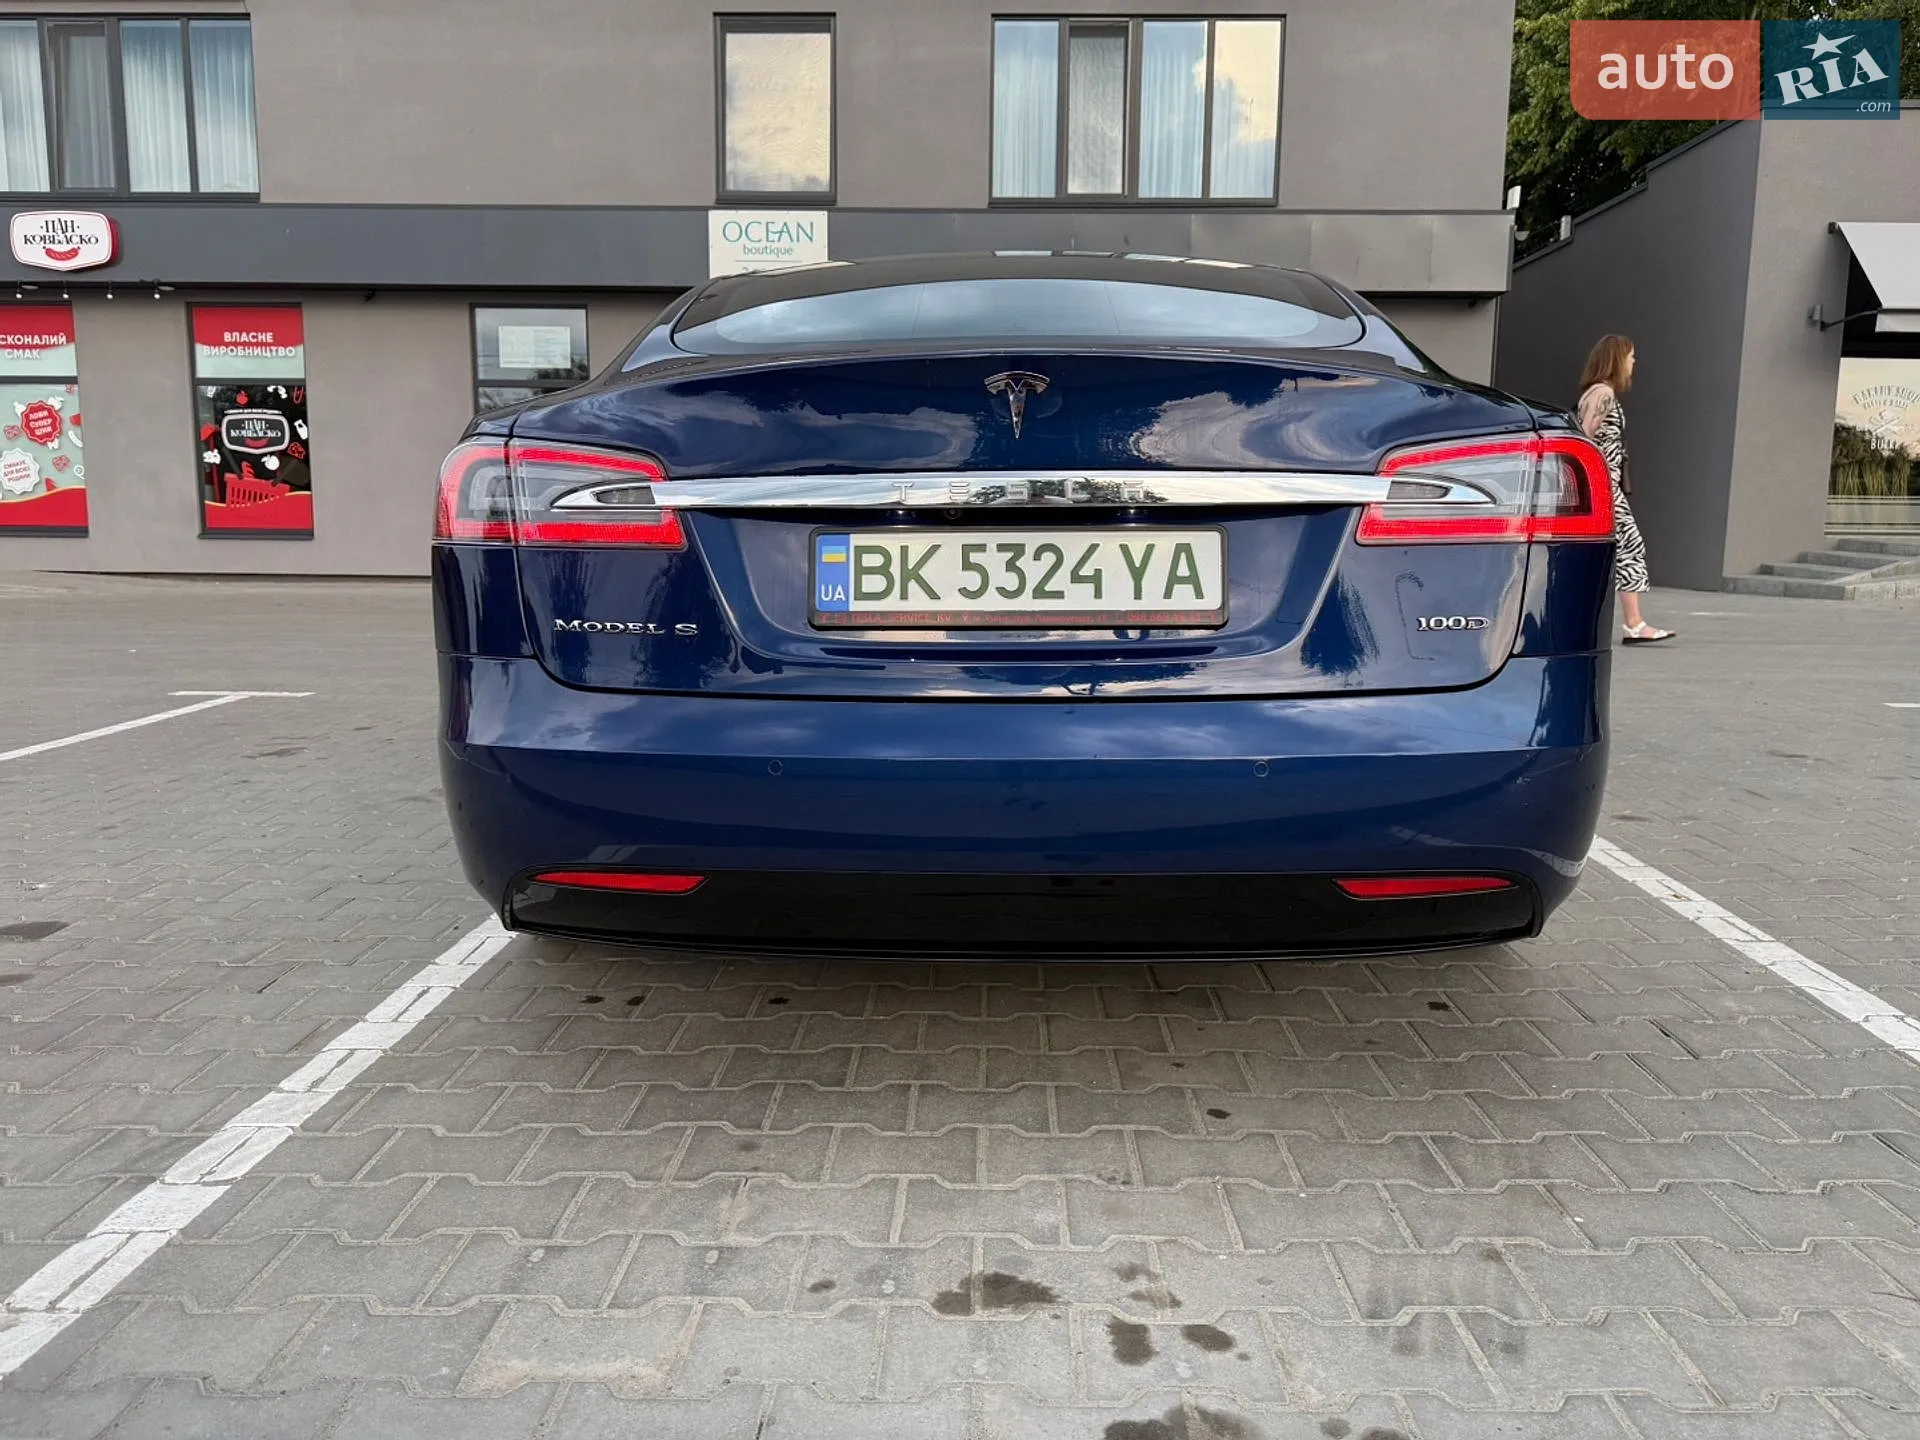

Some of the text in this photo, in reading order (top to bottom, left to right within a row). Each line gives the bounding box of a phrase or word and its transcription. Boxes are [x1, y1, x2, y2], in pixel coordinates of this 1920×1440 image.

[722, 221, 815, 243] OCEAN
[23, 234, 99, 245] КОВБАСКО
[743, 244, 794, 257] boutique
[223, 331, 274, 343] ВЛАСНЕ
[4, 348, 41, 359] СМАК
[203, 346, 296, 357] ВИРОБНИЦТВО
[892, 481, 1144, 502] TESLA
[821, 542, 1204, 601] UA BK 5324 YA
[554, 619, 698, 636] MODEL S
[1417, 616, 1489, 631] 100D
